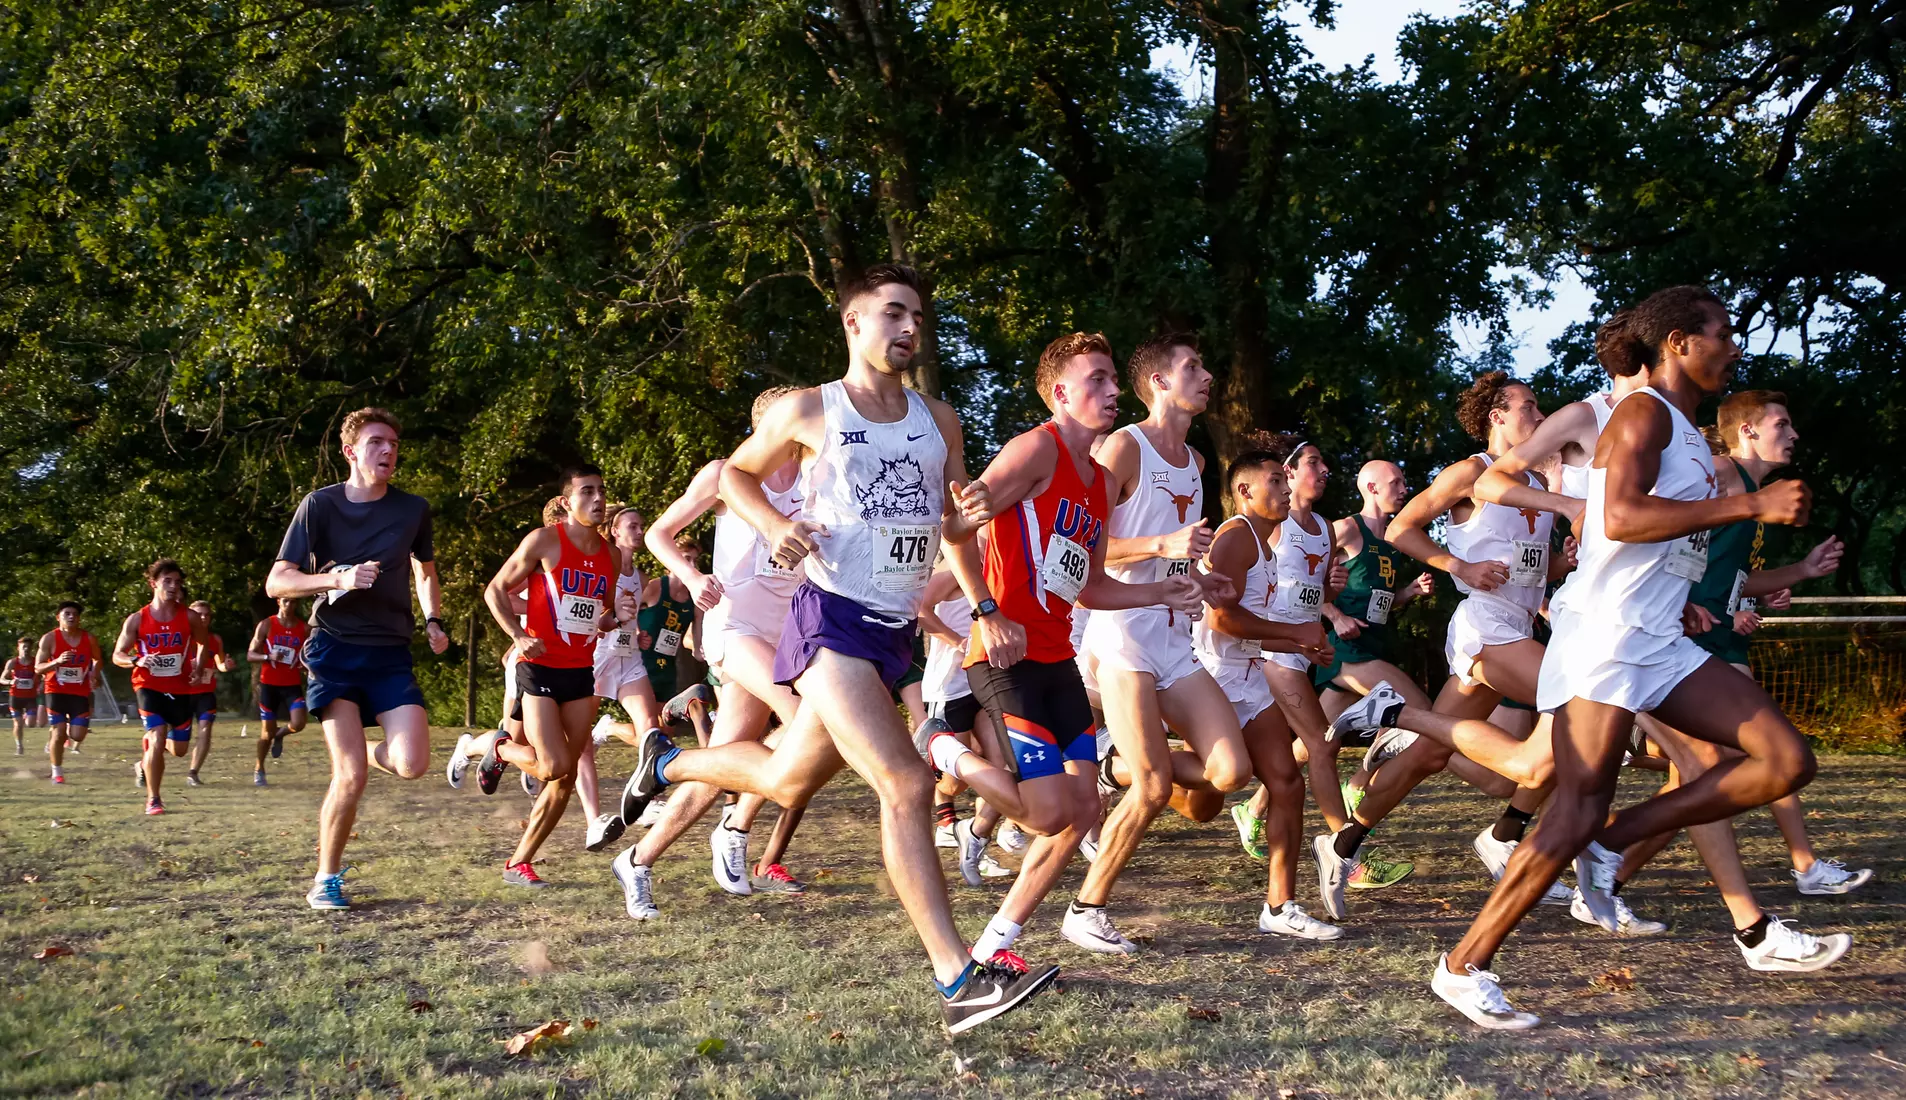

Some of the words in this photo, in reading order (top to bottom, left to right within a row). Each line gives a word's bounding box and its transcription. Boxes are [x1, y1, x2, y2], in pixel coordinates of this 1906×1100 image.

[839, 430, 869, 446] XII
[891, 528, 912, 537] Baylor
[890, 536, 928, 563] 476
[1522, 548, 1542, 568] 467
[884, 565, 905, 573] Baylor
[1060, 549, 1086, 581] 493
[562, 568, 608, 598] UTA
[1299, 588, 1320, 605] 468
[1377, 596, 1391, 610] 451
[570, 602, 595, 619] 489
[146, 632, 183, 648] UTA
